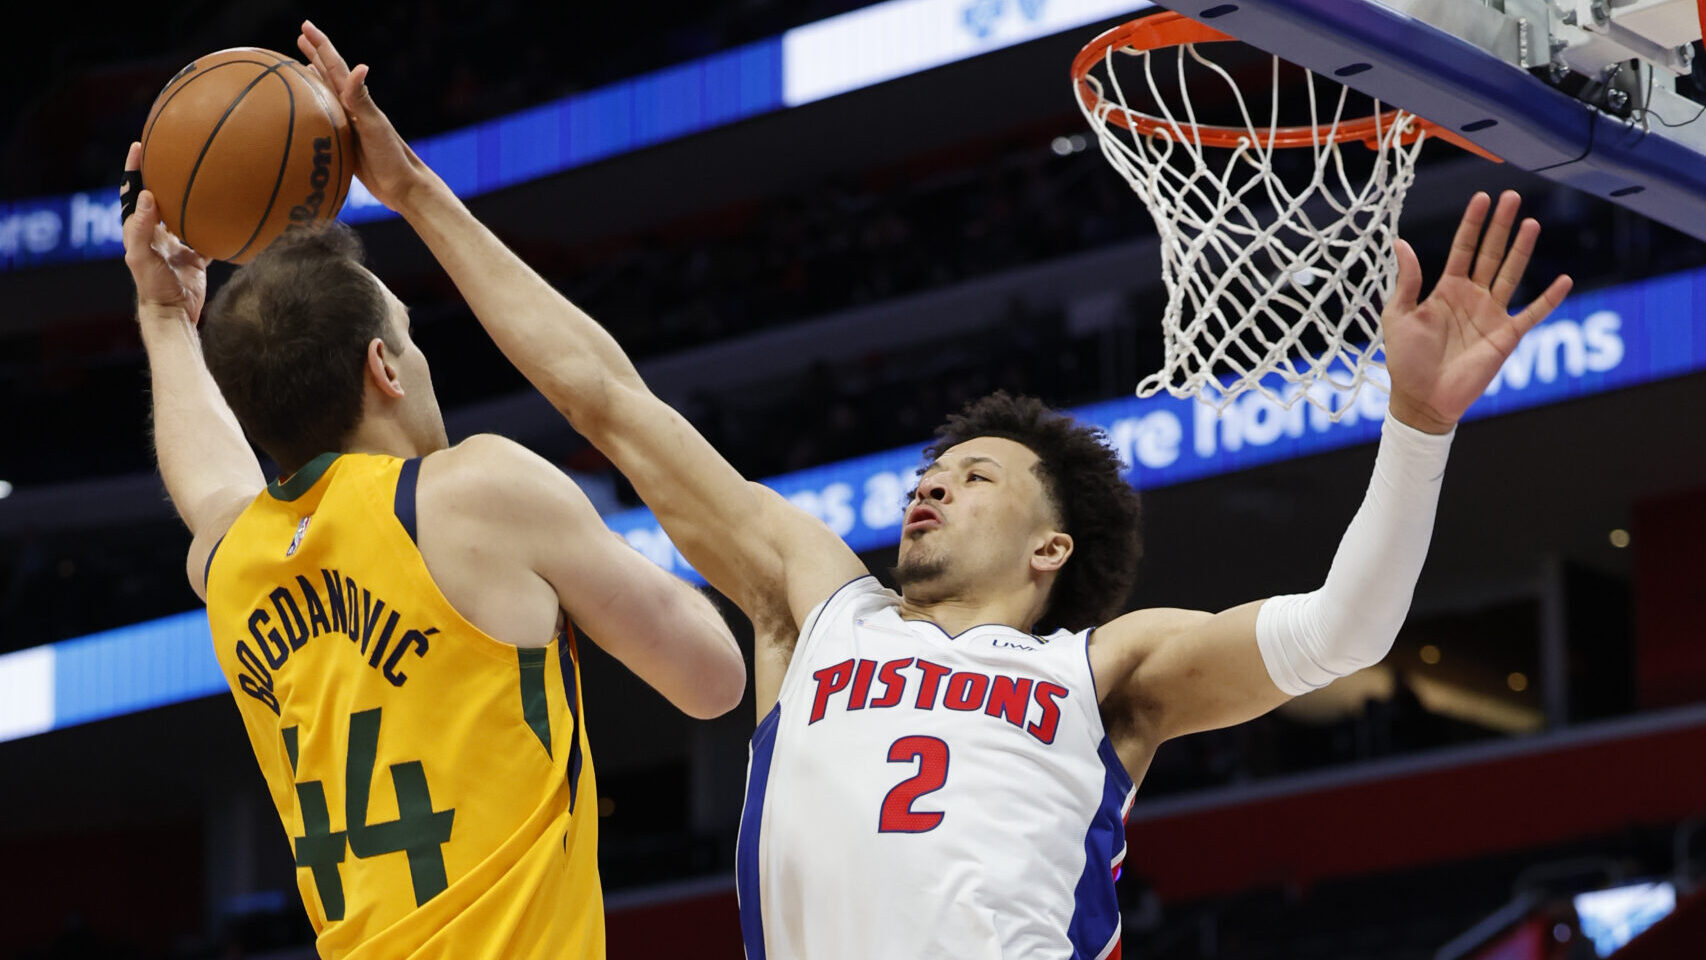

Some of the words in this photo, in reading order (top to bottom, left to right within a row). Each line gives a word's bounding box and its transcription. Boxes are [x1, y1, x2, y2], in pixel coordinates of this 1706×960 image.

[236, 569, 441, 718] BOGDANOVIĆ
[808, 657, 1069, 745] PISTONS
[281, 707, 456, 922] 44
[878, 735, 950, 833] 2
